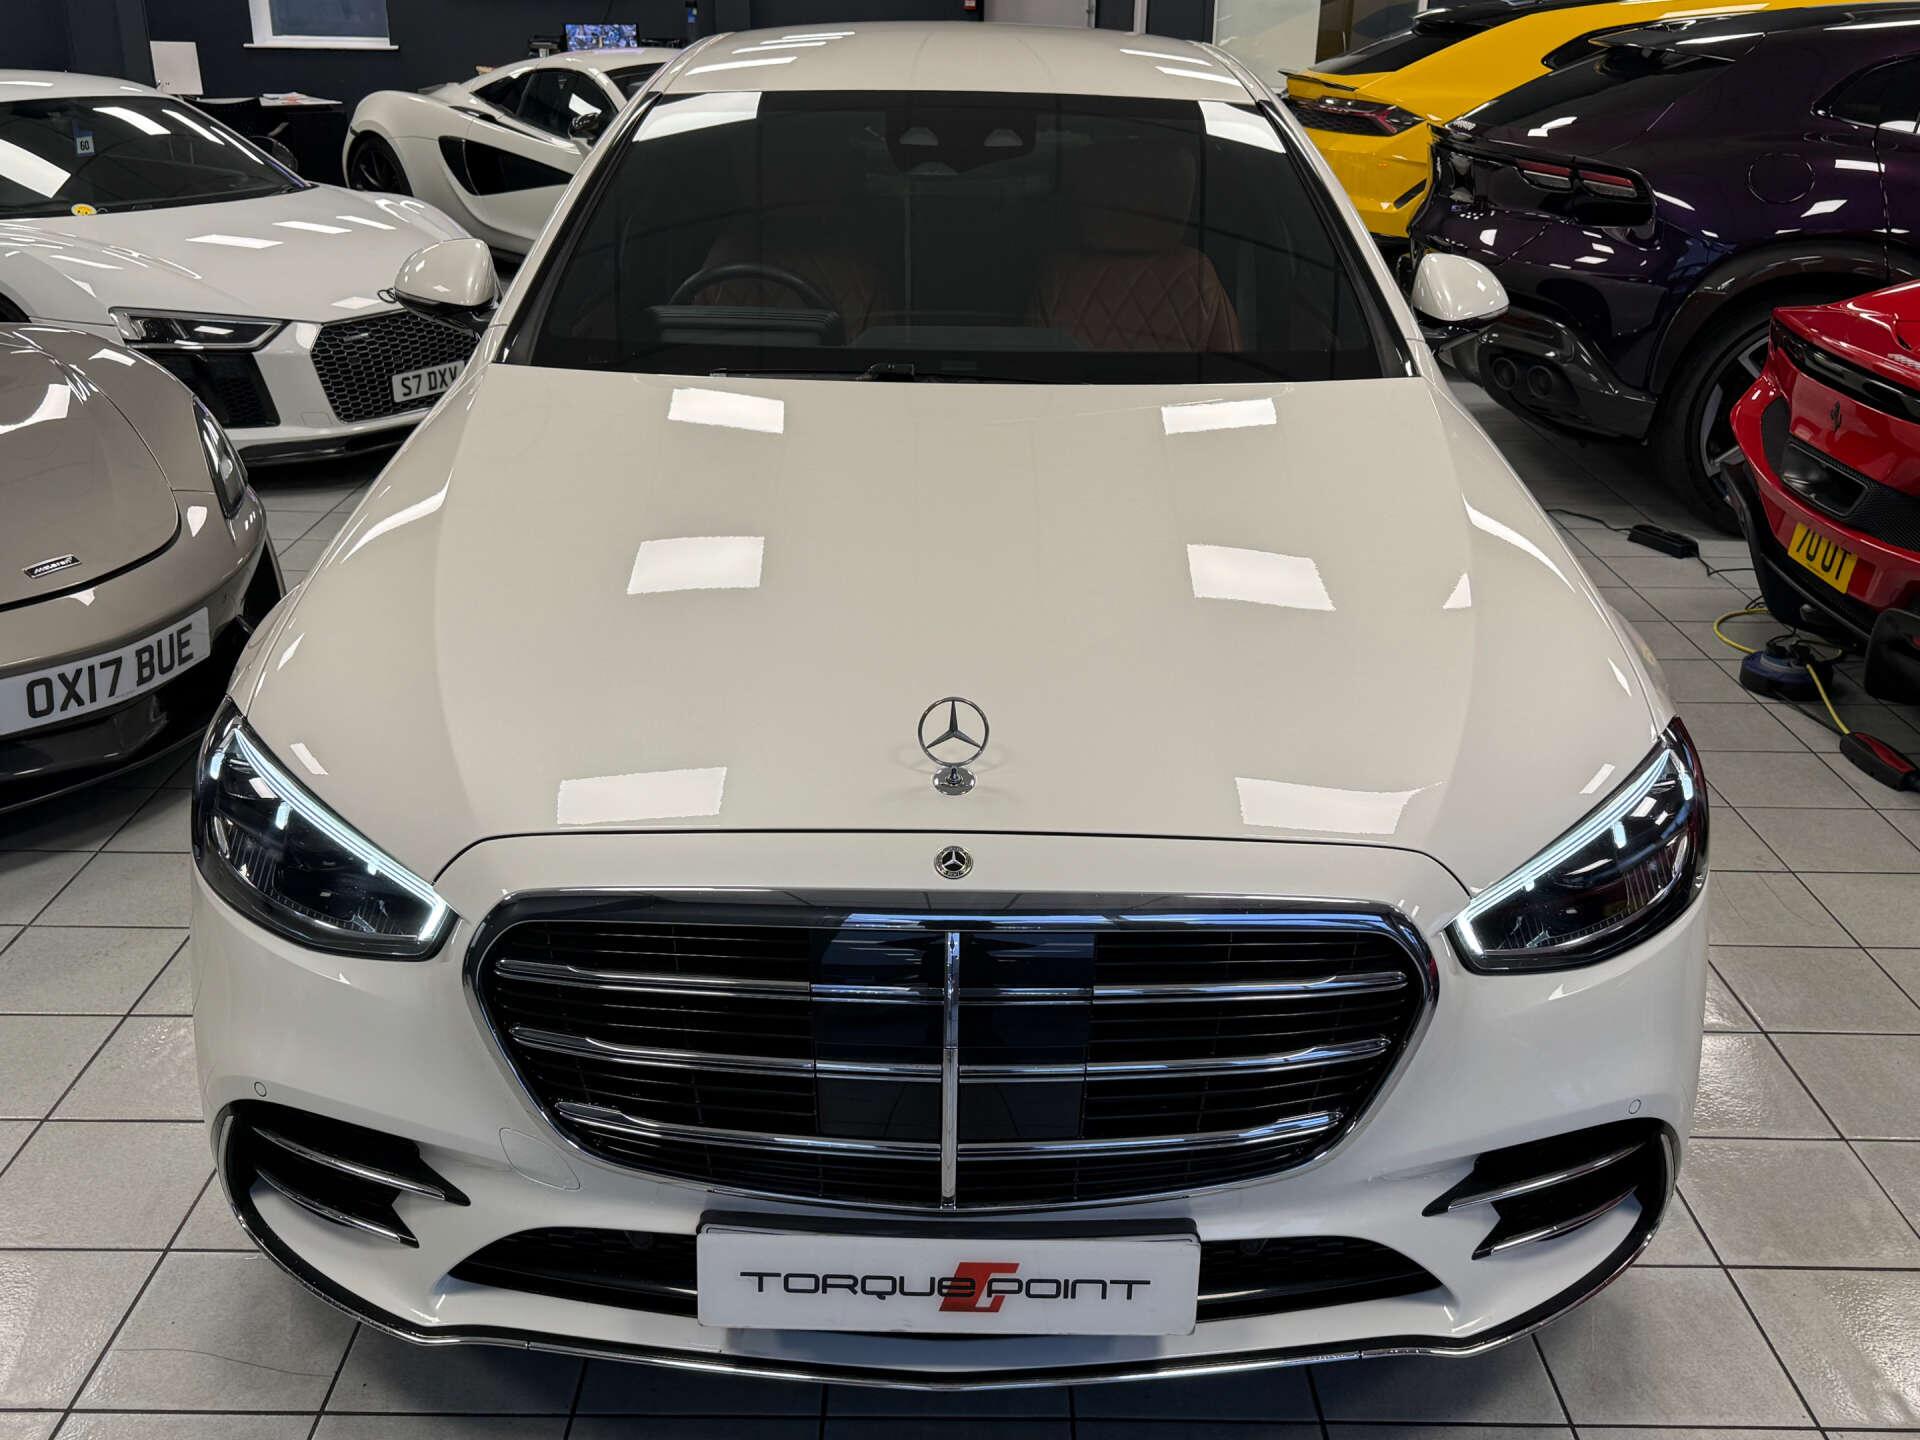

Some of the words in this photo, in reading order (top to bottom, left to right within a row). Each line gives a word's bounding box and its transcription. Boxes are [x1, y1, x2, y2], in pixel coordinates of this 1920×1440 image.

[401, 375, 422, 397] S7
[26, 656, 123, 719] OX17
[135, 623, 194, 687] BUE
[740, 1272, 976, 1300] TORQUE
[987, 1277, 1151, 1300] POINT
